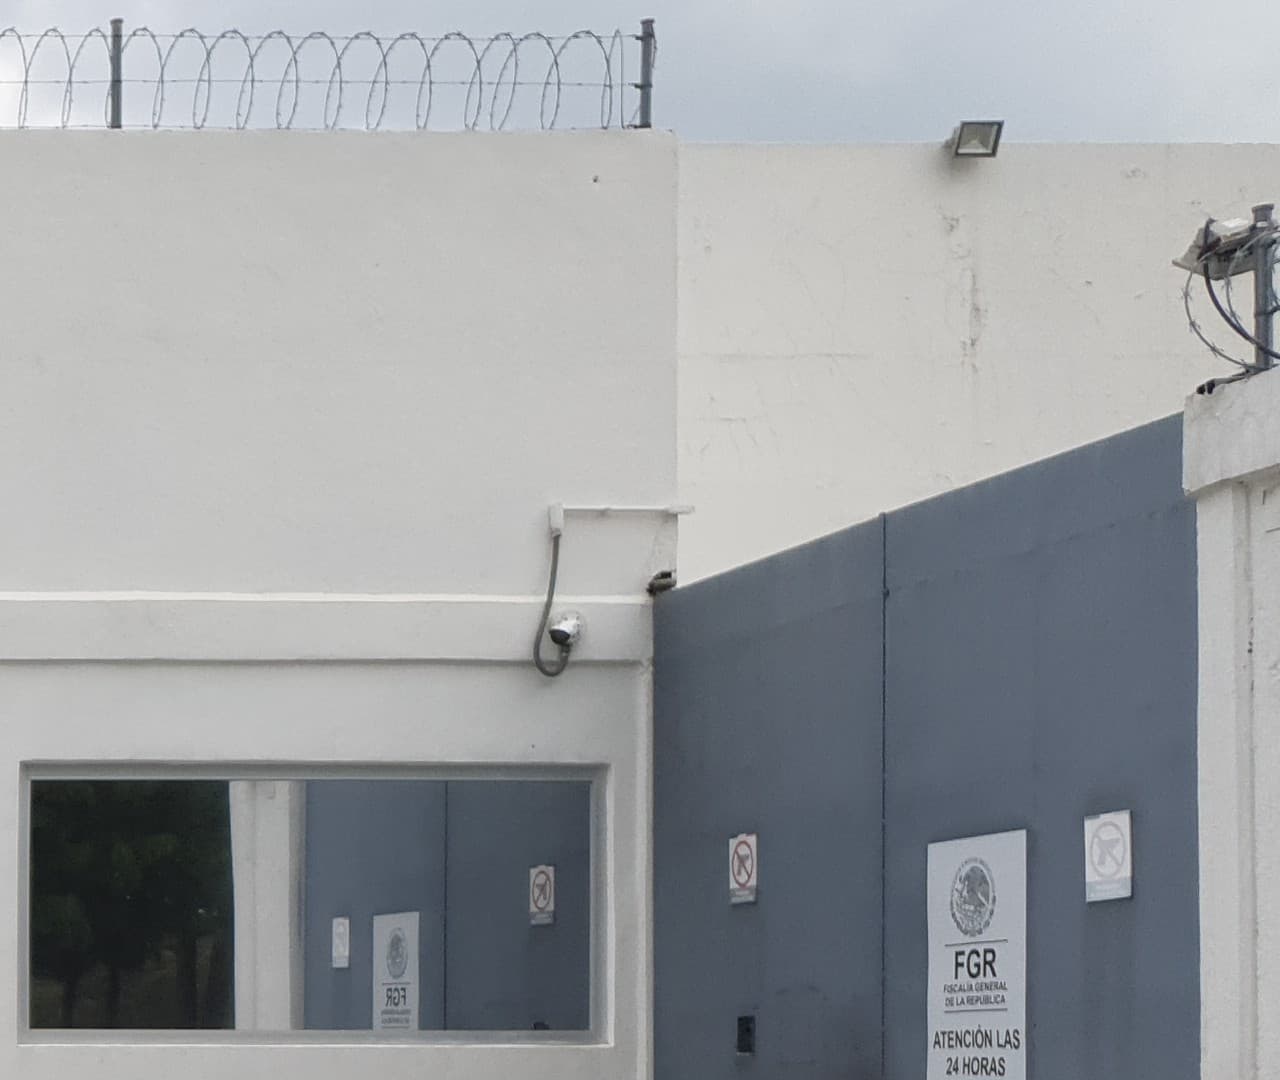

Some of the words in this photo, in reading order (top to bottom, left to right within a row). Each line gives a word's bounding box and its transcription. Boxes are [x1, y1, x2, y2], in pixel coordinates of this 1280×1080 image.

[954, 947, 997, 980] FGR
[974, 980, 1009, 992] GENERAL
[945, 996, 955, 1007] DE
[956, 995, 966, 1007] LA
[933, 1023, 994, 1049] ATENCIÓN
[996, 1028, 1021, 1050] LAS
[946, 1056, 959, 1075] 24
[962, 1056, 1006, 1077] HORAS
